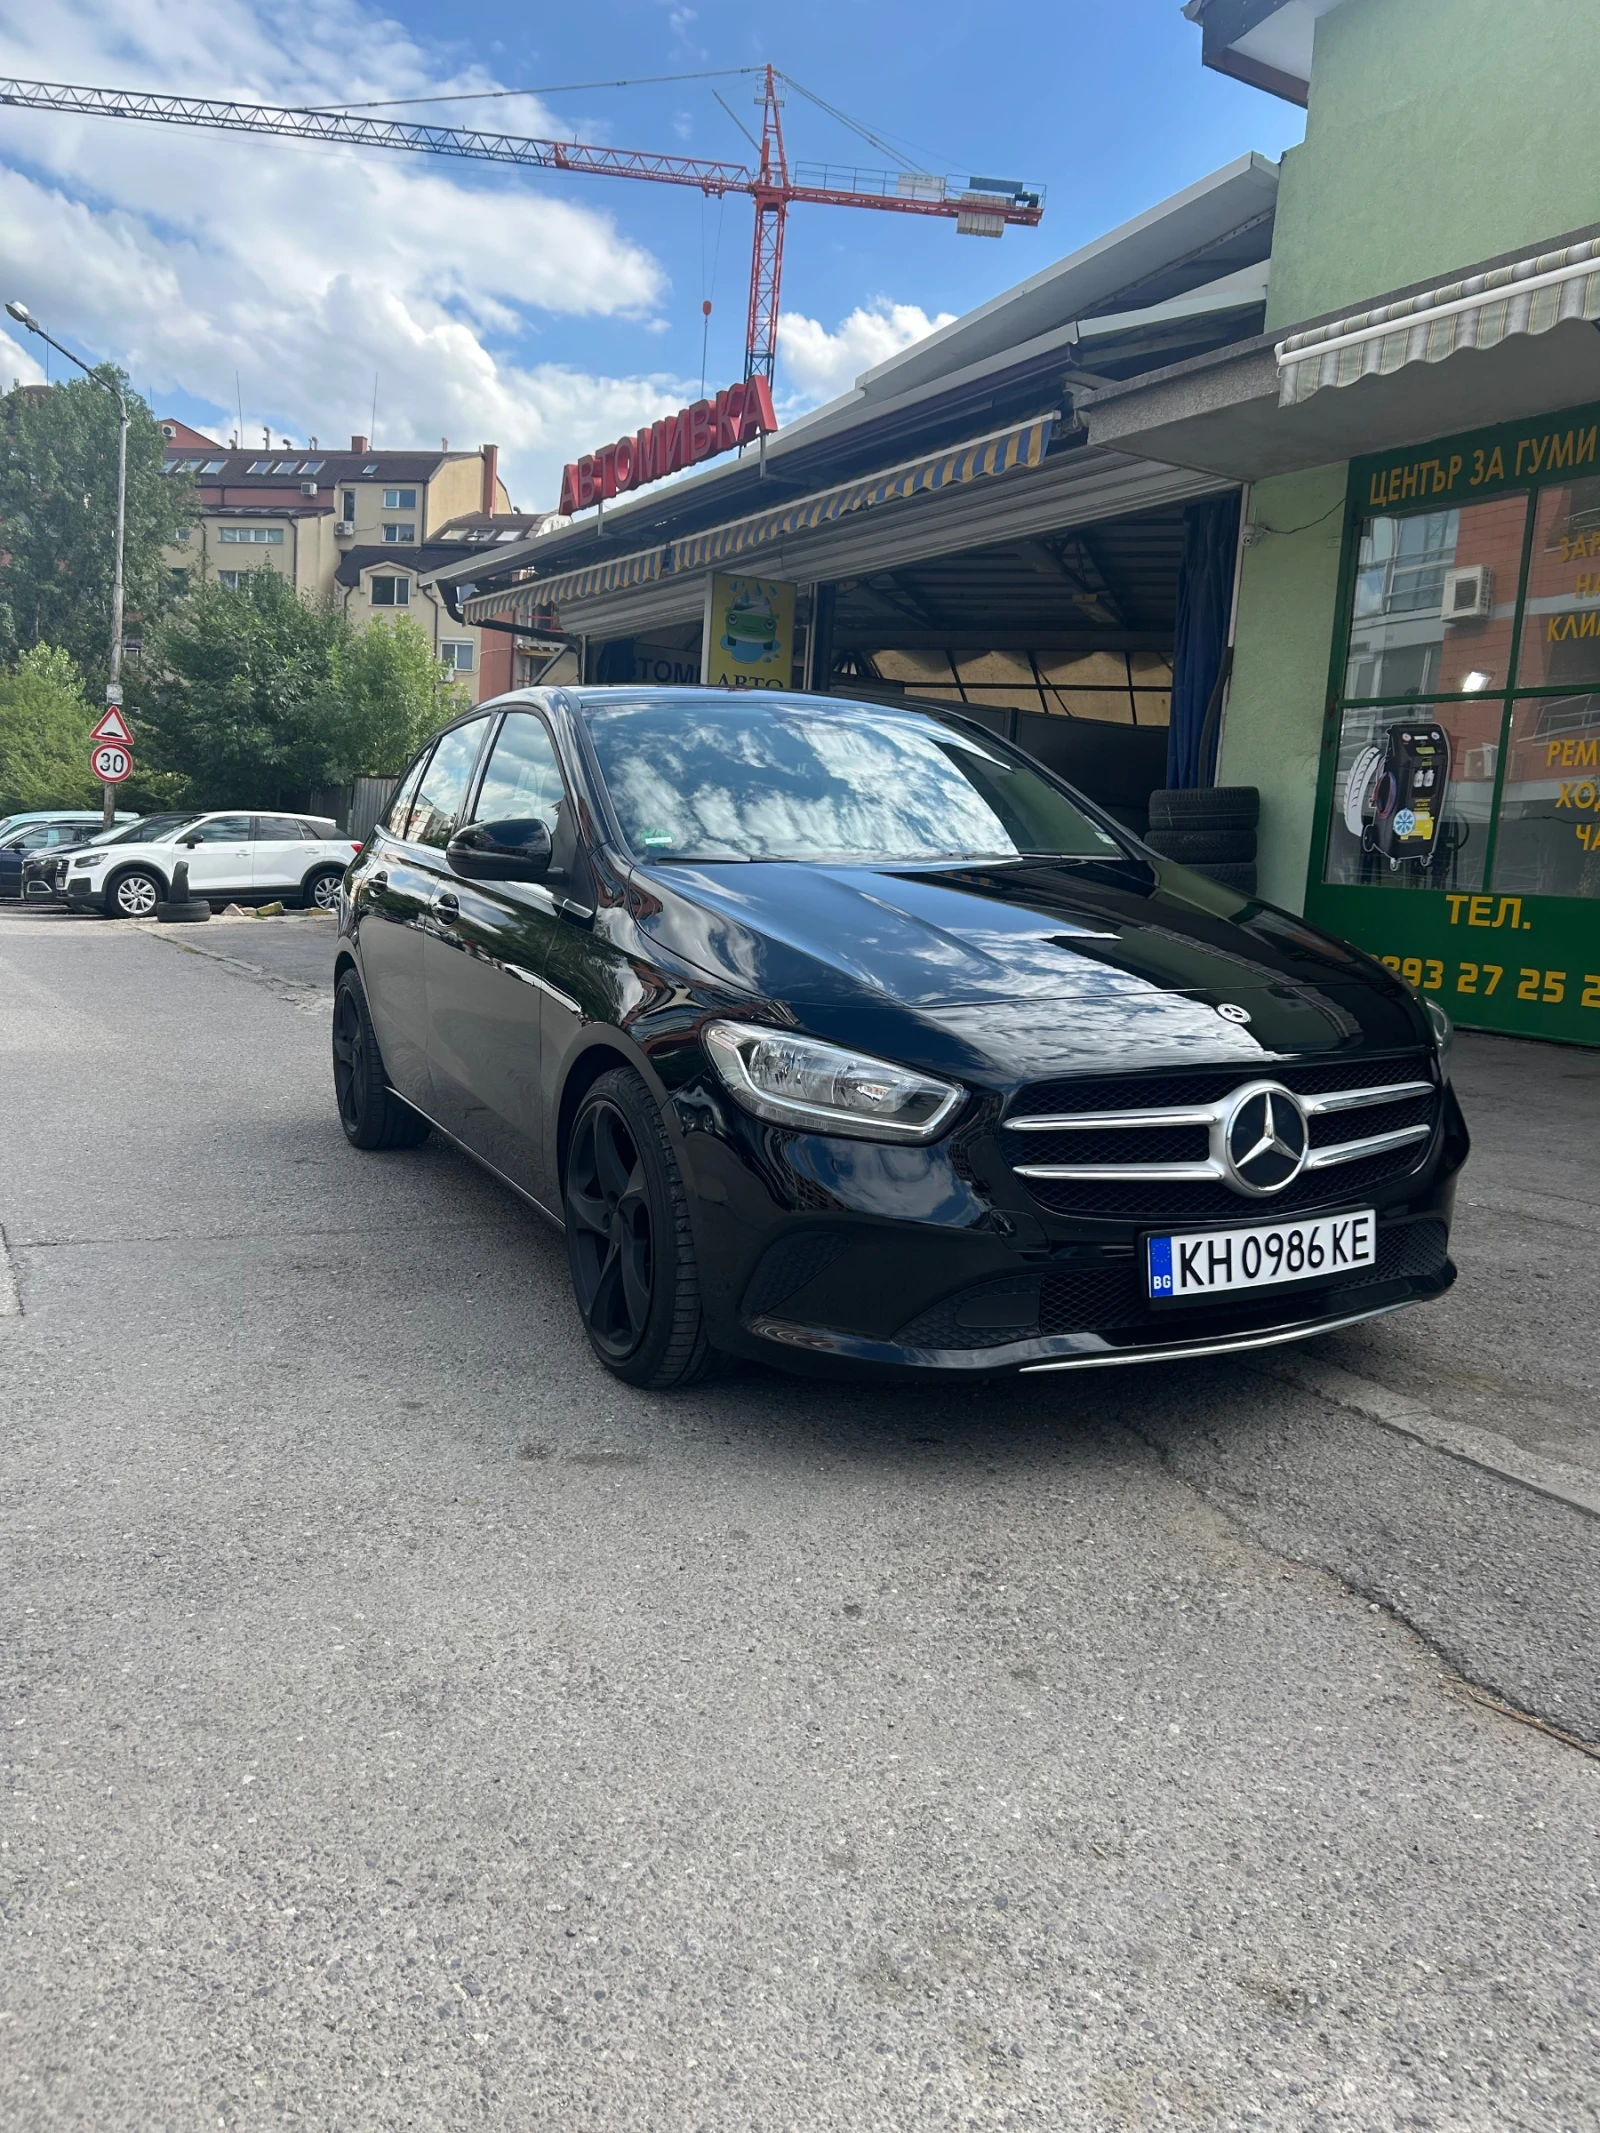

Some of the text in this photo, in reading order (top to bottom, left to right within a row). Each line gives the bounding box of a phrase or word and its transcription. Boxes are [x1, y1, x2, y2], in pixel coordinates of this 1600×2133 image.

[558, 374, 778, 516] АВТОМИВКА
[1369, 425, 1598, 508] ЦЕНТЪР ЗА ГУМИ
[1547, 611, 1600, 642] КЛИ
[632, 656, 701, 684] ТОМ
[100, 752, 124, 773] 30
[1555, 781, 1600, 812] ХО
[1445, 894, 1532, 930] ТЕЛ.
[1370, 954, 1444, 989] 93
[1457, 962, 1504, 996] 27
[1517, 967, 1567, 1004] 25
[1153, 1275, 1171, 1290] BG
